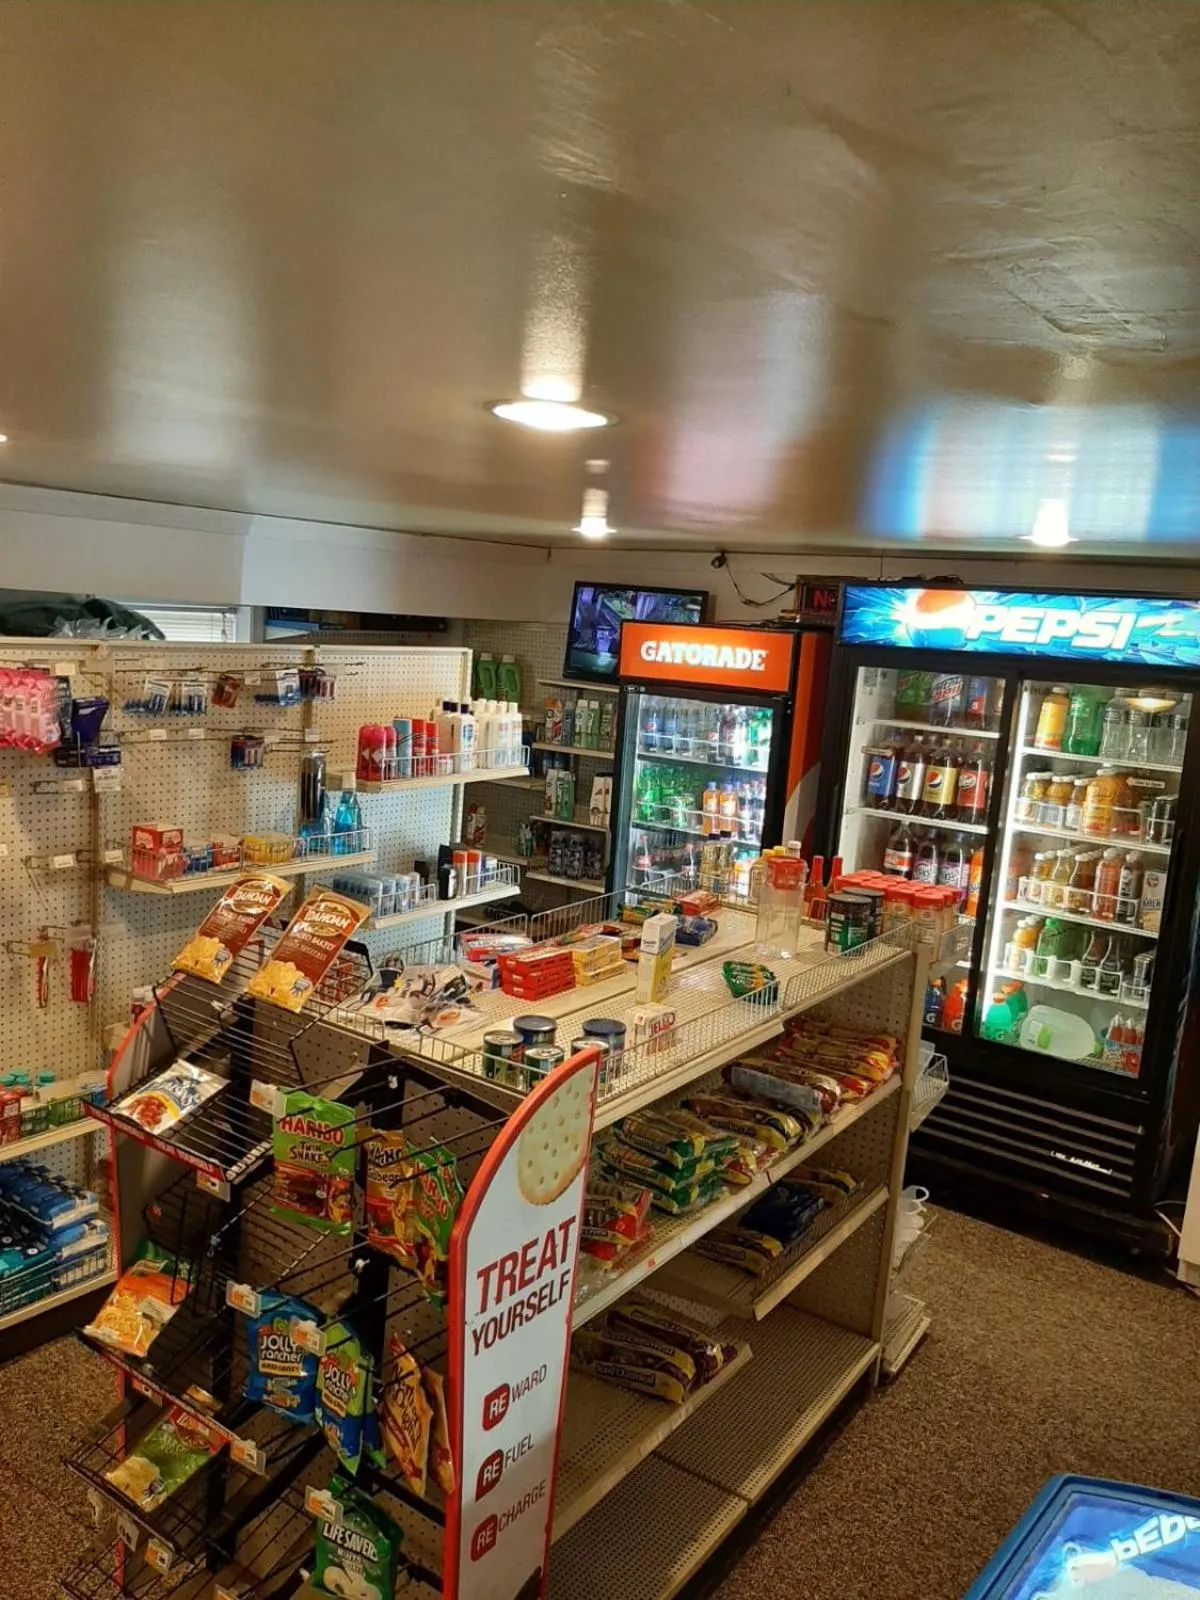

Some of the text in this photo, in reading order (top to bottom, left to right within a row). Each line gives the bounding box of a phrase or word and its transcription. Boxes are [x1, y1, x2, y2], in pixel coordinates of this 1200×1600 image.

[966, 604, 1137, 649] PEPSI
[640, 640, 768, 672] GATORADE
[279, 1115, 345, 1146] HARIBO
[476, 1215, 576, 1315] TREAT
[471, 1268, 571, 1357] YOURSELF
[260, 1334, 298, 1352] JOLLY
